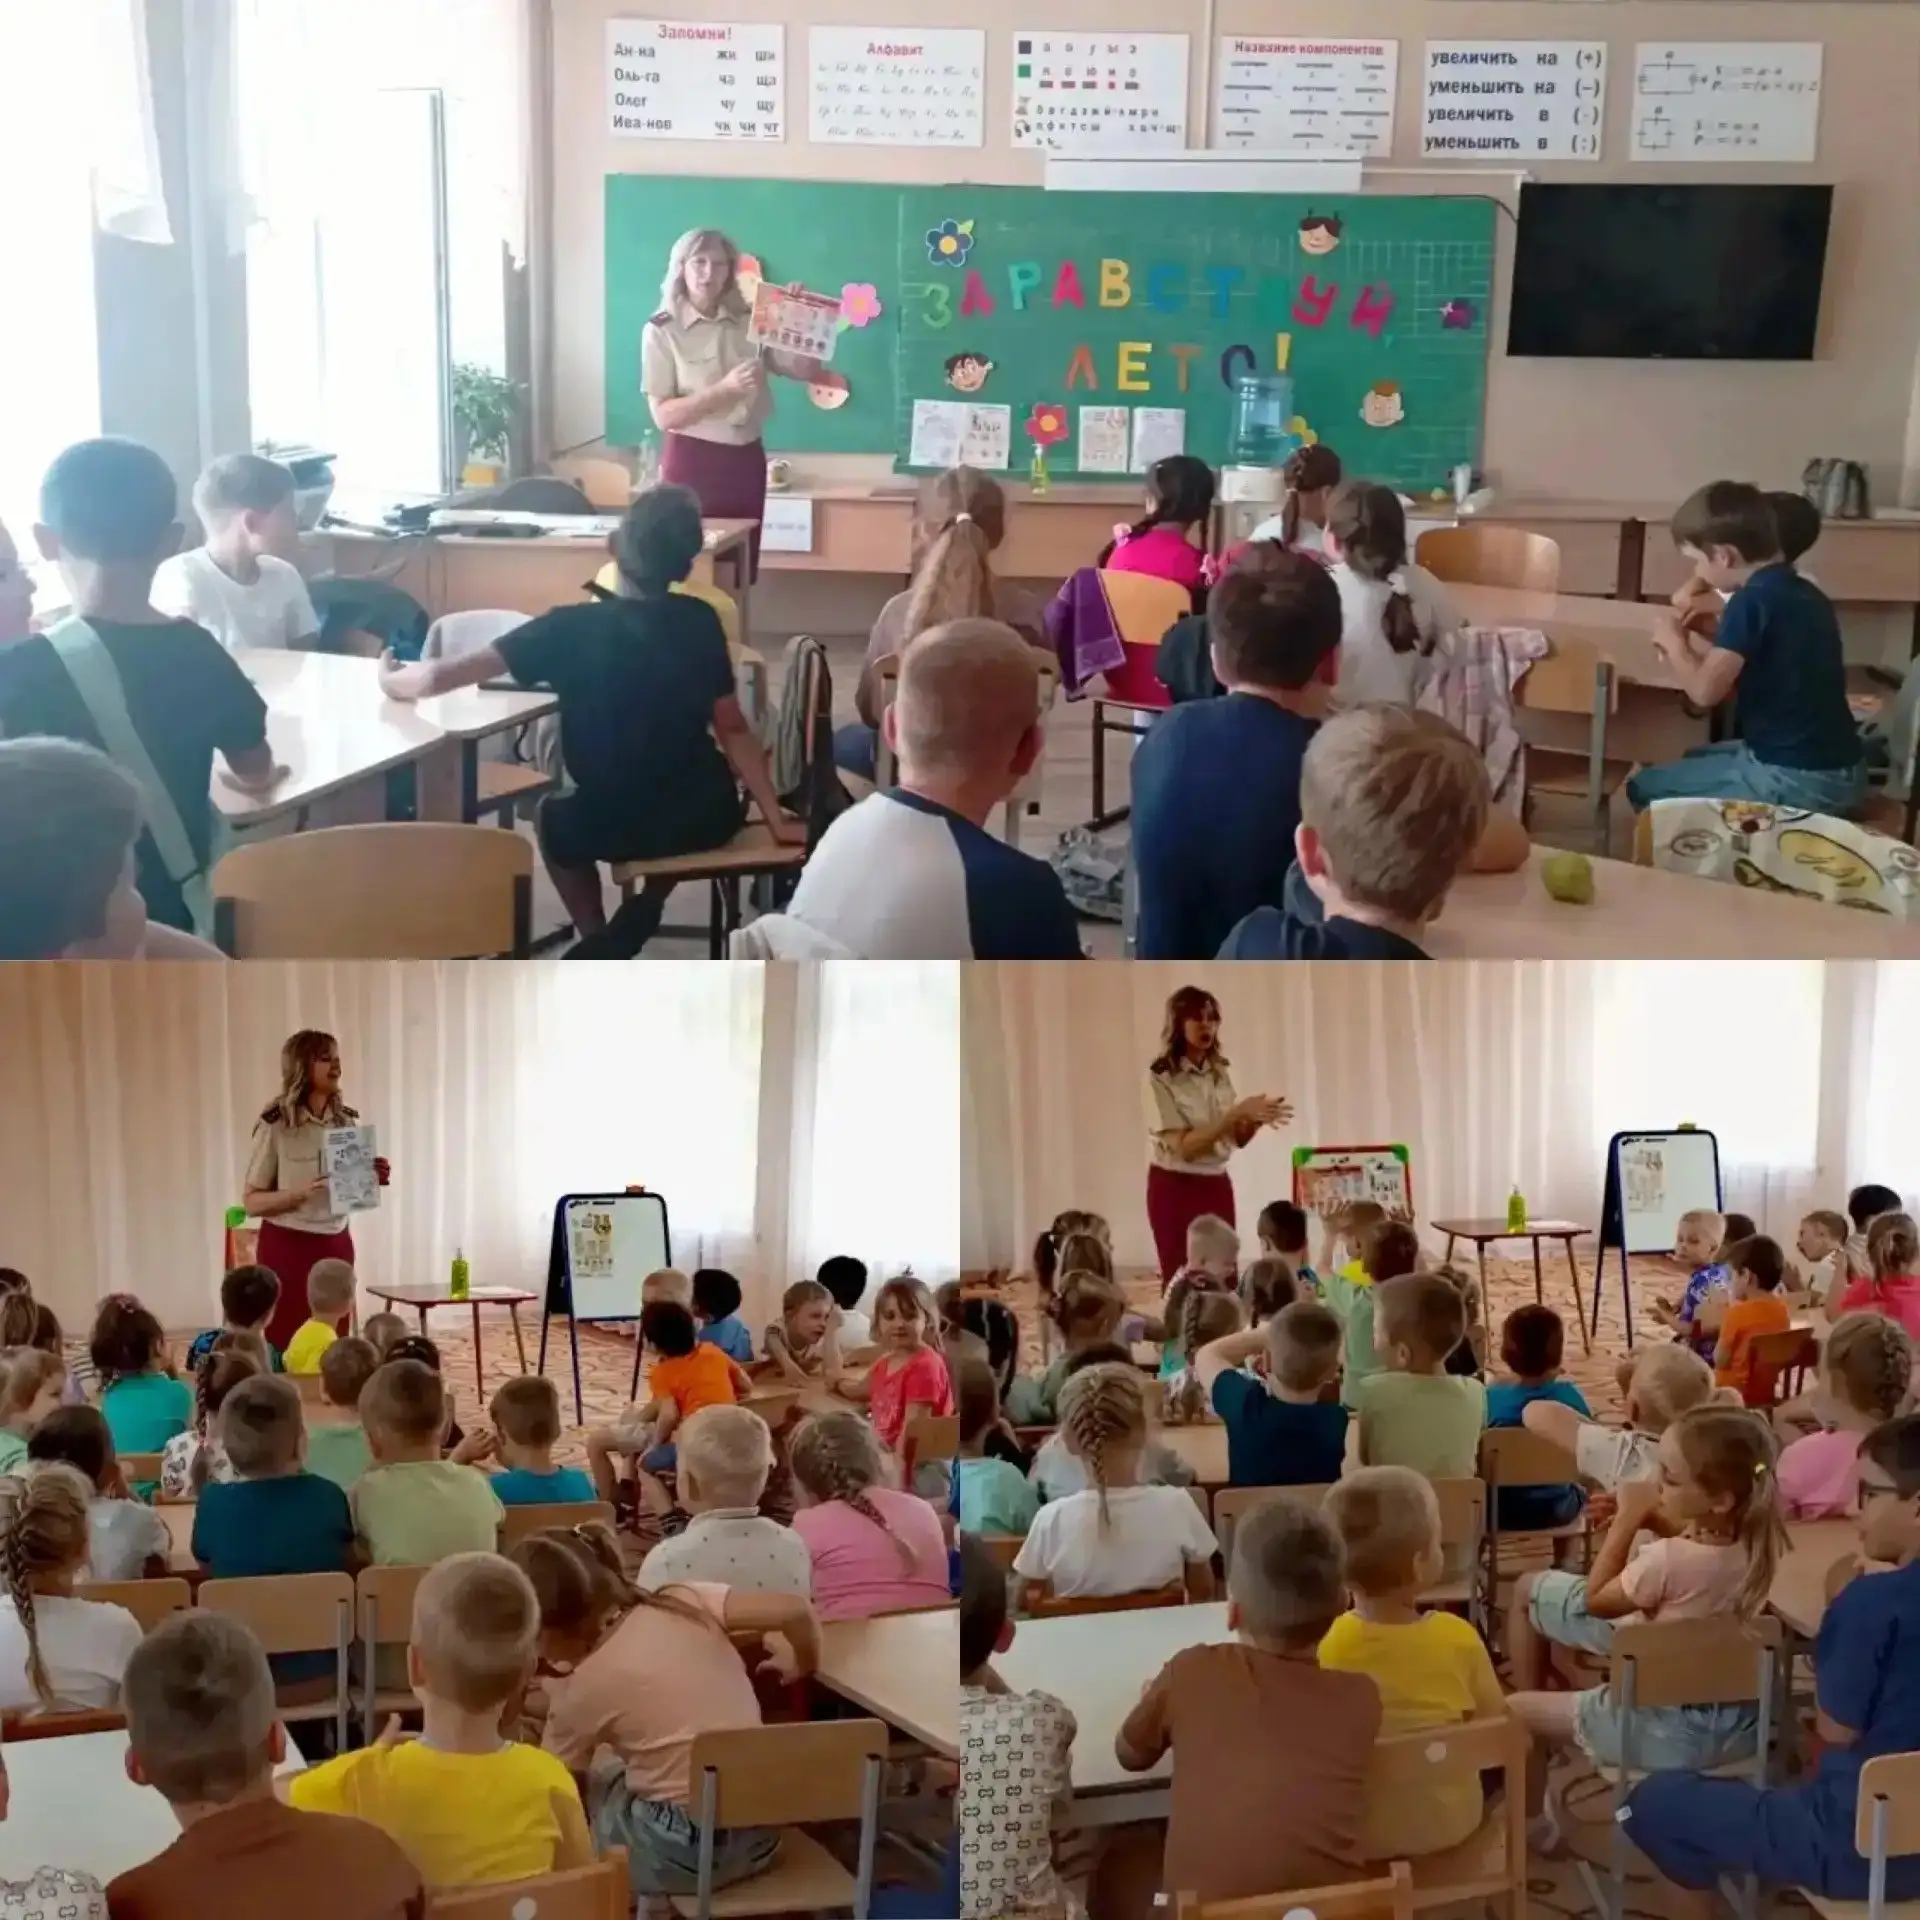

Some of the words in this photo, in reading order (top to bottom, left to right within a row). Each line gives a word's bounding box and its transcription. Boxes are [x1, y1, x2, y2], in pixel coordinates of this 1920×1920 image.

[658, 24, 731, 40] Запомни!
[614, 42, 655, 58] Ан-на
[717, 50, 736, 61] жи
[755, 51, 775, 61] ши
[866, 42, 923, 56] Алфавит
[1431, 52, 1517, 67] увеличить
[1537, 53, 1557, 65] на
[614, 68, 660, 83] Оль-га
[719, 75, 735, 85] ча
[757, 76, 777, 87] ща
[1429, 80, 1524, 96] уменьшить
[1534, 81, 1555, 94] на
[615, 93, 647, 107] Олег
[721, 100, 735, 113] чу
[613, 115, 672, 129] Ива-нов
[715, 122, 731, 132] чк
[764, 123, 780, 133] чт
[1428, 109, 1513, 123] увеличить
[1539, 110, 1549, 121] в
[1425, 136, 1520, 152] уменьшить
[1537, 138, 1547, 149] в
